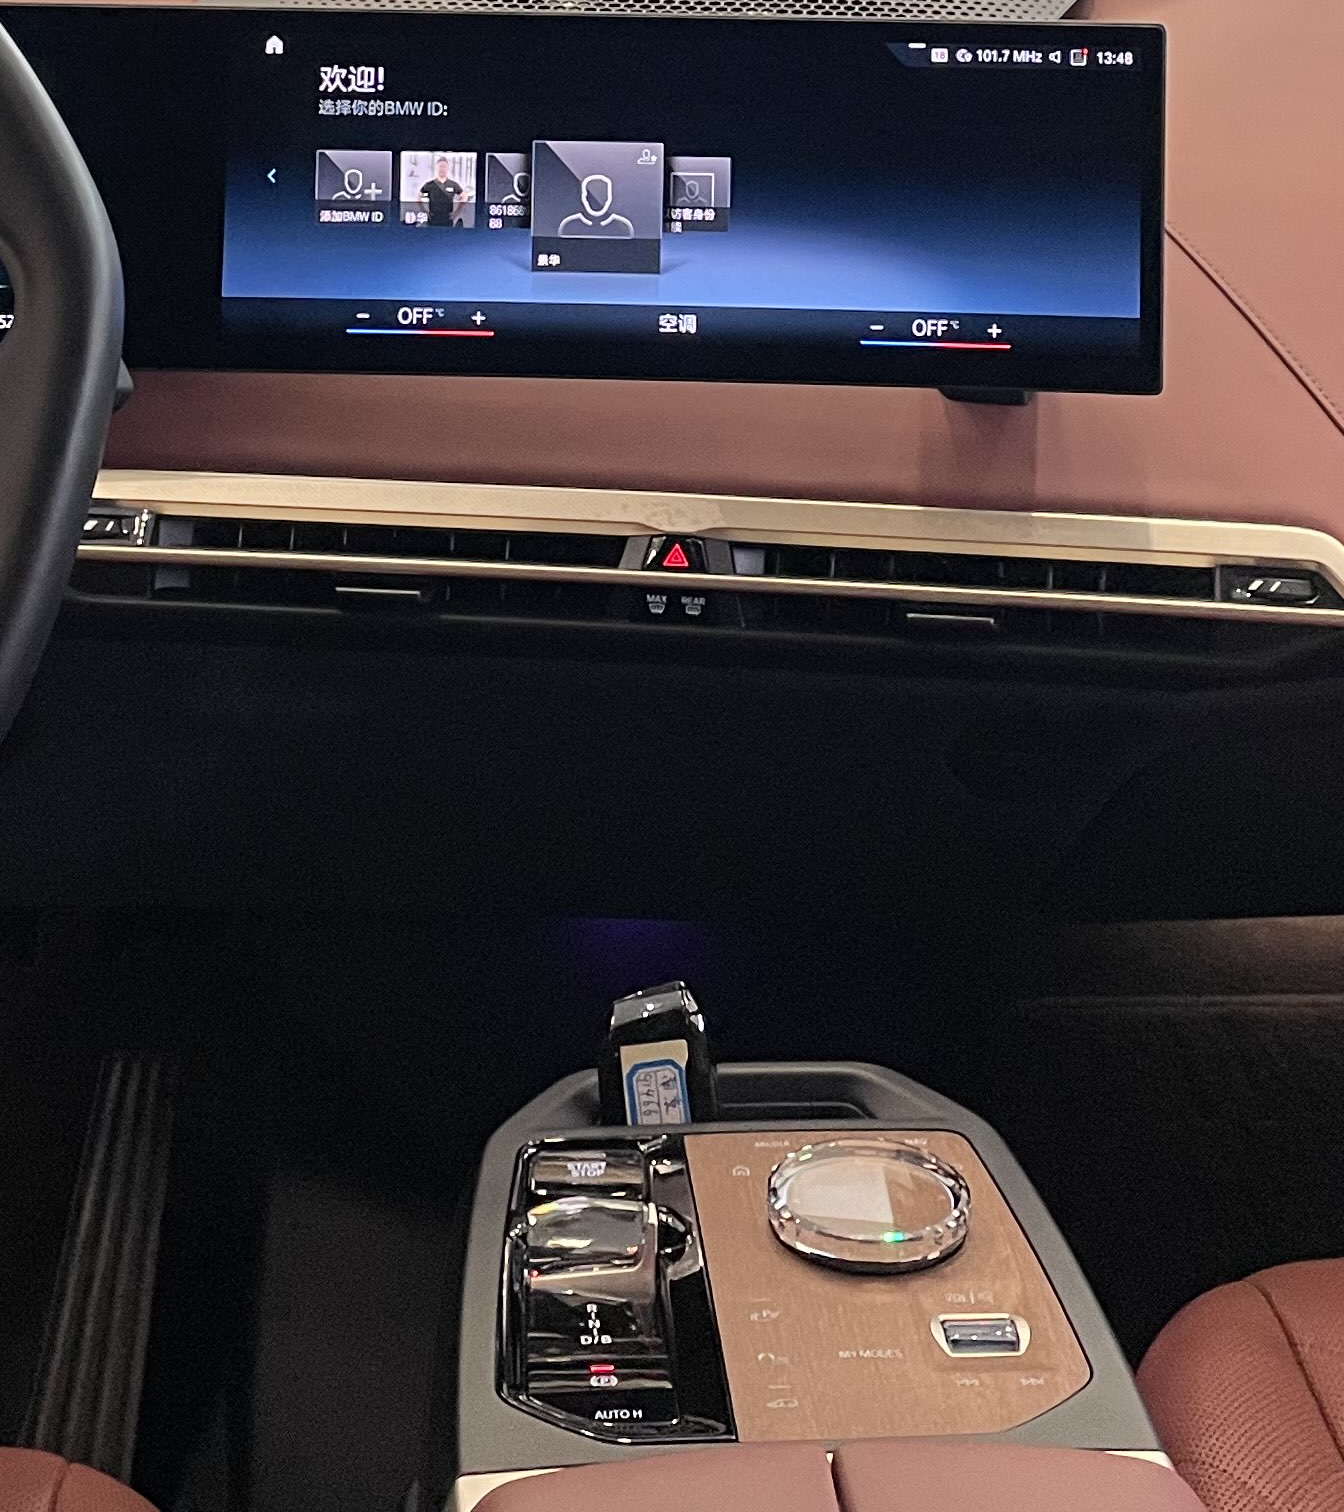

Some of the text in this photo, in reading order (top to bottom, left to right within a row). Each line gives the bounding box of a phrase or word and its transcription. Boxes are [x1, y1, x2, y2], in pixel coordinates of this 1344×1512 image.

[976, 49, 1042, 63] 101.7 MHz
[1096, 52, 1133, 65] 13:48
[318, 65, 385, 93] 欢迎!
[318, 99, 448, 116] 选择你的BMW ID:
[319, 210, 384, 222] 添加BMW ID
[489, 205, 529, 216] 861868
[489, 218, 502, 229] 88
[398, 307, 433, 324] OFF
[658, 314, 697, 334] 空调
[912, 318, 948, 337] OFF
[646, 594, 667, 604] MAX
[681, 596, 706, 606] REAR
[567, 1161, 607, 1171] START
[570, 1168, 605, 1178] STOP
[594, 1409, 643, 1420] AUTO H
